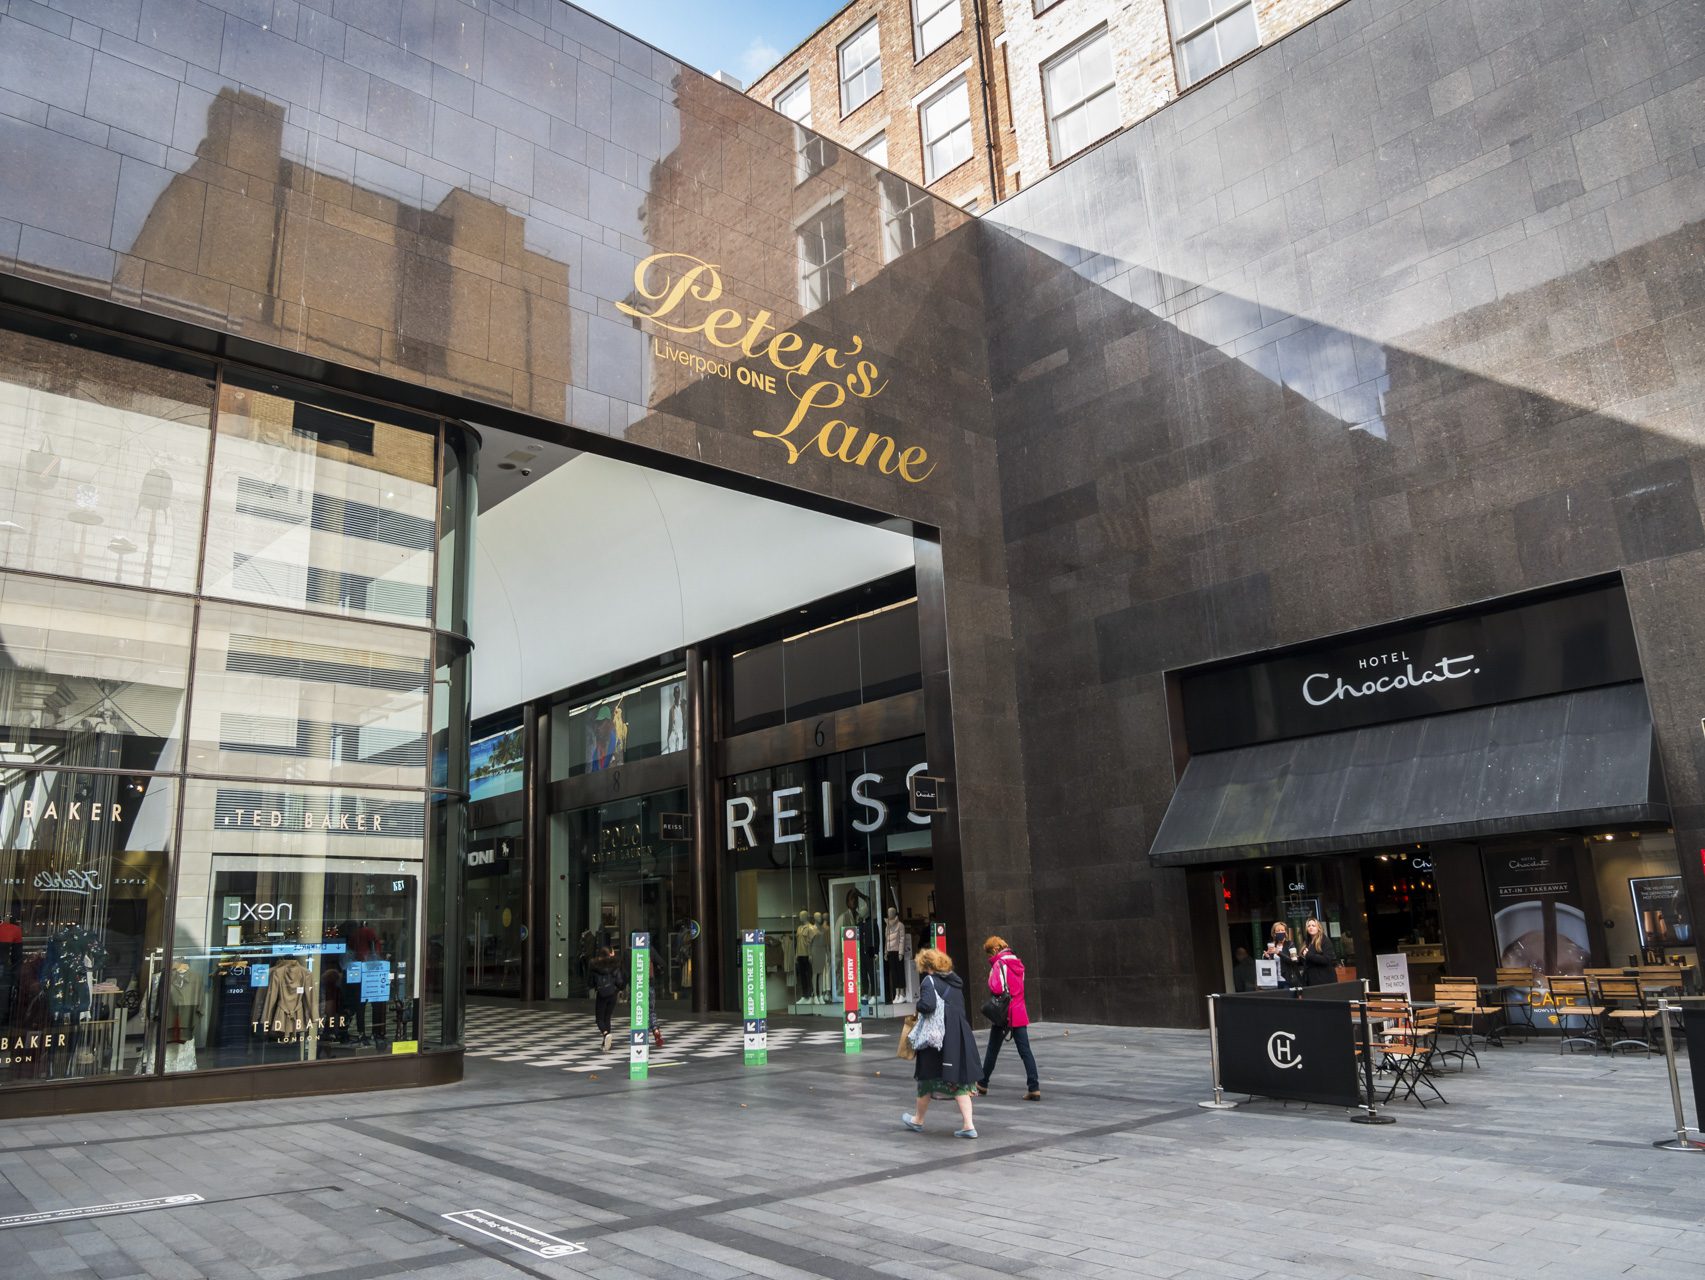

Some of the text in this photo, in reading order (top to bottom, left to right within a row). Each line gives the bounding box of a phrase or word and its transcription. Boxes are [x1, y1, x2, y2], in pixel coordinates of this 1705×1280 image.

[615, 253, 889, 399] Peter's
[654, 338, 777, 395] Liverpool ONE
[752, 370, 938, 483] Lane
[1358, 651, 1410, 669] HOTEL
[814, 720, 825, 747] 6
[612, 770, 620, 792] 8
[23, 799, 123, 822] BAKER
[234, 808, 382, 832] TED BAKER
[467, 849, 495, 867] ONI
[1529, 884, 1568, 892] TAKEAWAY
[636, 953, 644, 972] LEFT
[748, 984, 754, 997] TO
[848, 982, 854, 993] NO
[636, 991, 643, 1005] TO
[252, 1016, 346, 1033] TED BAKER
[0, 1034, 66, 1050] BAKER
[277, 1035, 320, 1043] LONDON
[0, 1055, 32, 1064] DON
